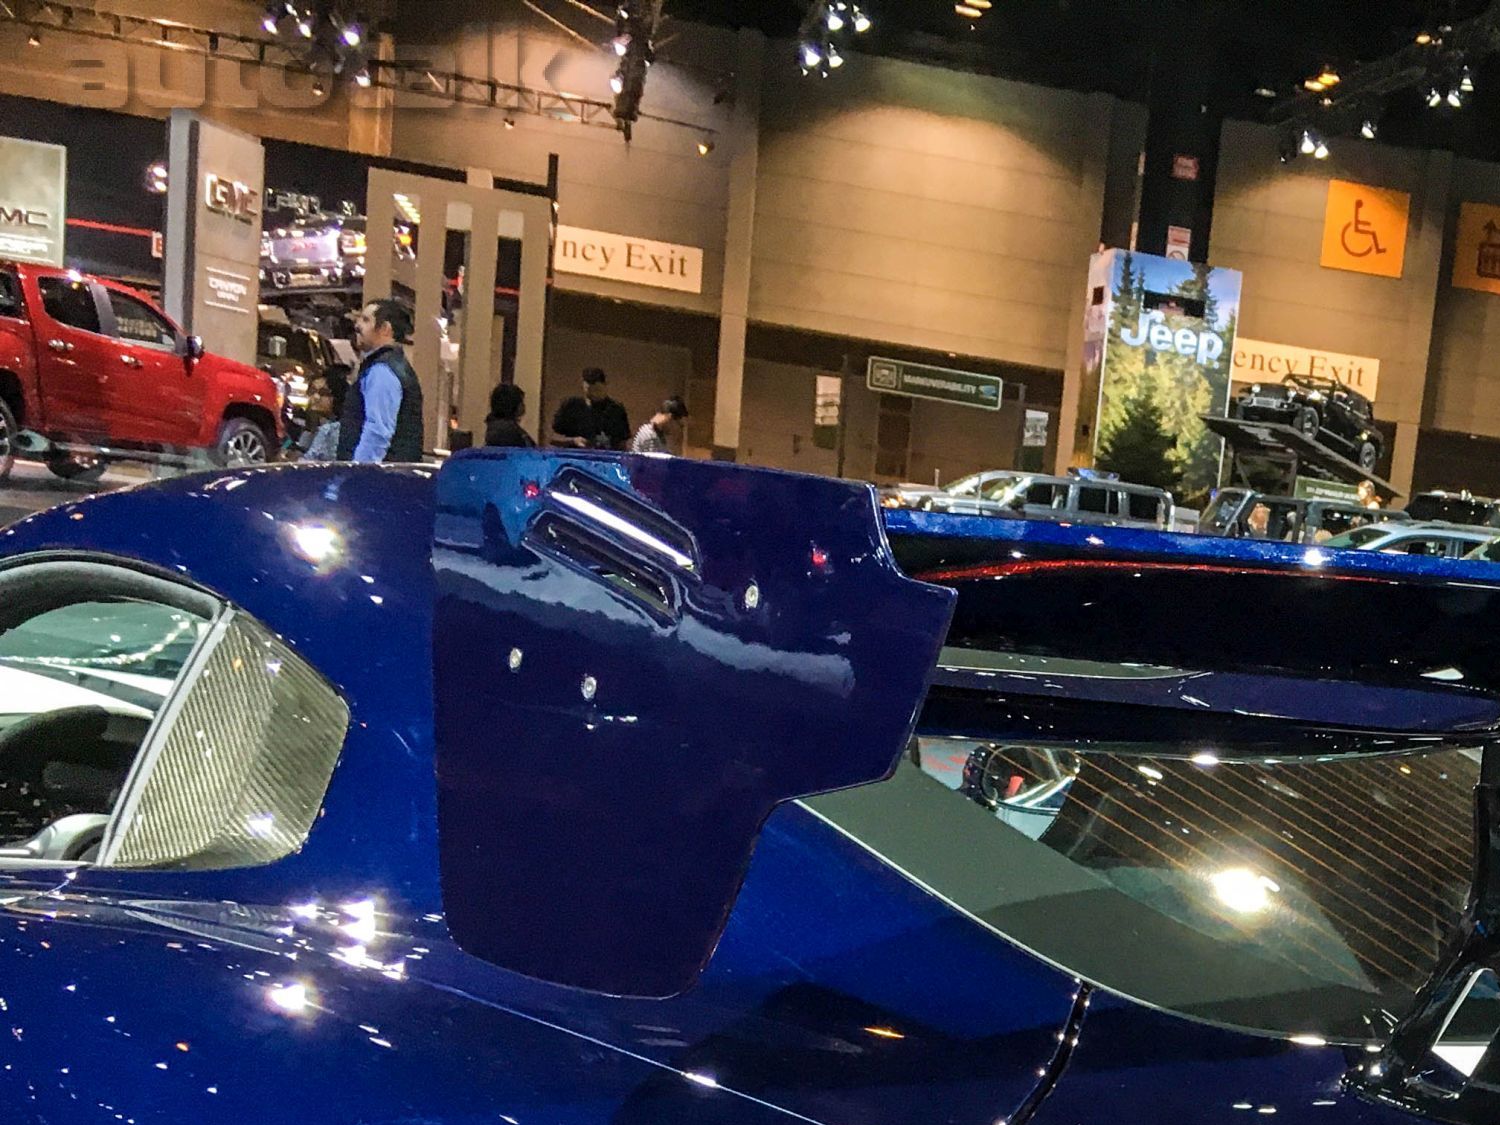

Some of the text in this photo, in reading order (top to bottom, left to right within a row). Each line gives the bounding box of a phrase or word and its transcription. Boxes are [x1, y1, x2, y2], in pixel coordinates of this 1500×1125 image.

[204, 173, 258, 216] GMC
[625, 242, 688, 277] Exit
[1119, 308, 1222, 369] Jeep
[1308, 355, 1365, 387] Exit
